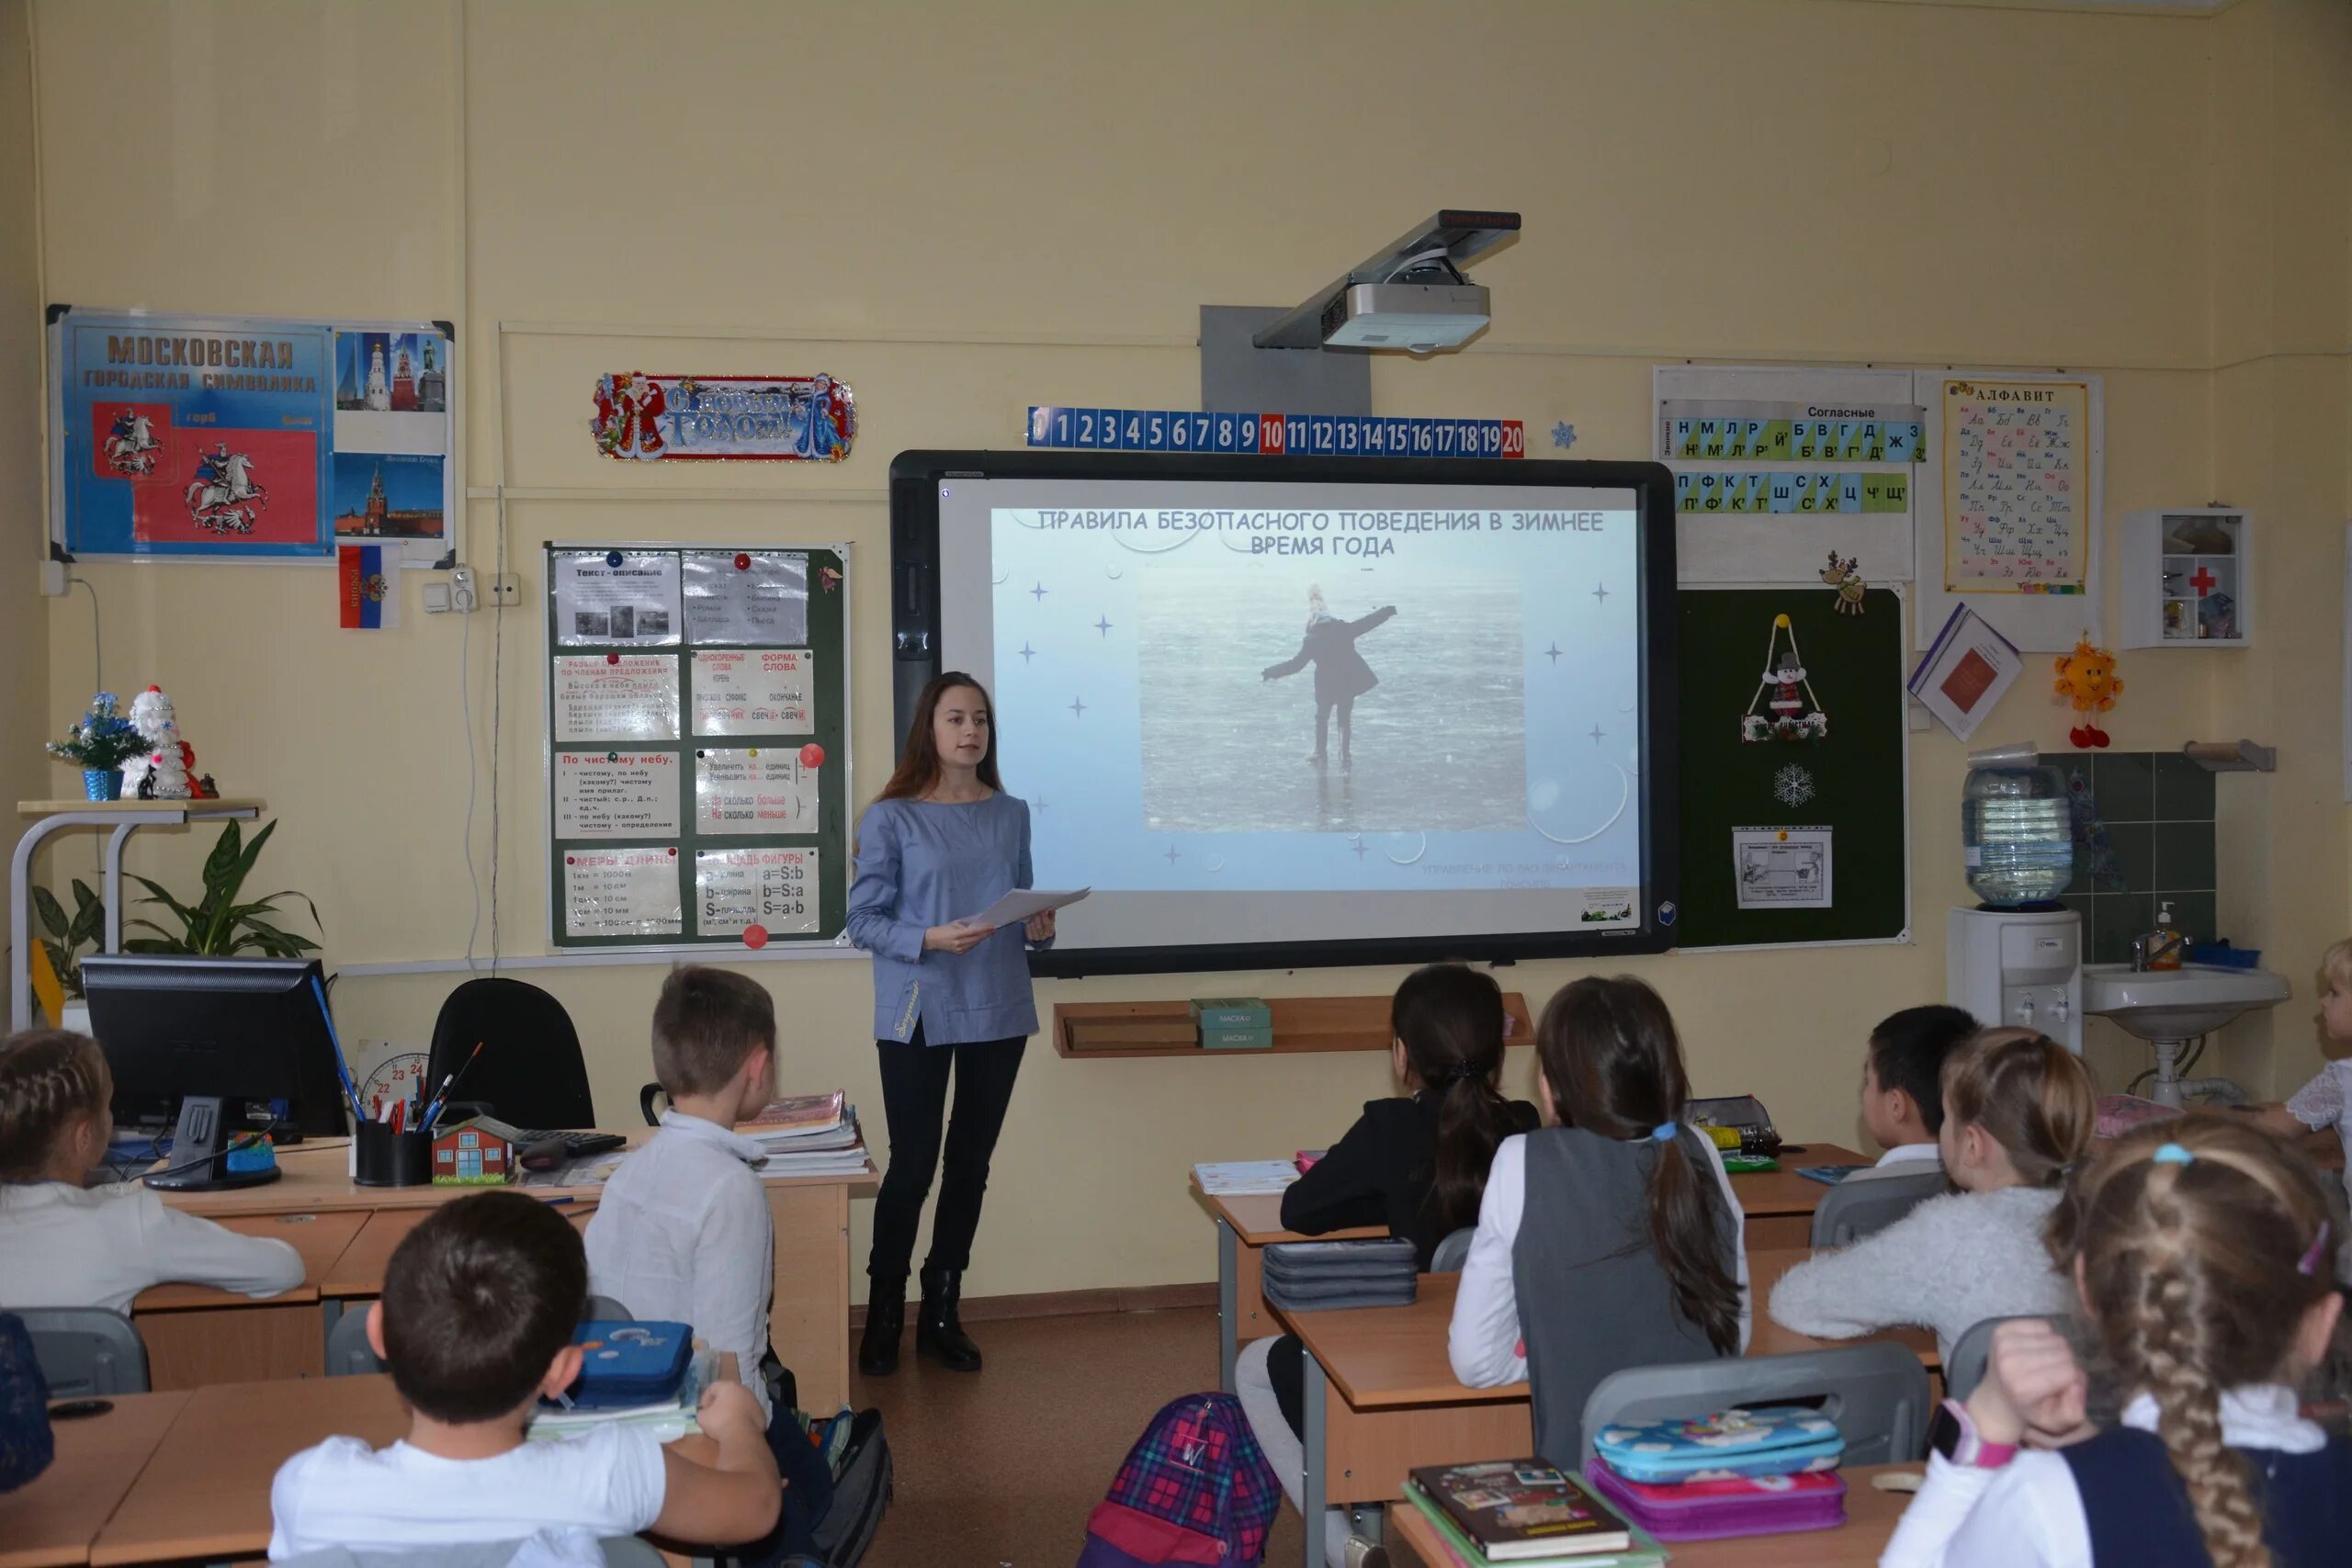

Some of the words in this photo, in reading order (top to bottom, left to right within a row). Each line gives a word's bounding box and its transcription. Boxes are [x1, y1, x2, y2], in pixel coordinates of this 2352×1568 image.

[107, 335, 293, 369] МОСКОВСКАЯ
[84, 370, 190, 390] ГОРОДСКАЯ
[202, 373, 316, 392] СИМВОЛИКА
[664, 387, 690, 412] С
[1976, 390, 2054, 401] АЛФАВИТ
[1808, 407, 1874, 417] Согласные
[1034, 413, 1046, 440] 0
[1058, 415, 1067, 441] 1
[1080, 415, 1092, 442] 2
[1103, 416, 1115, 443] 3
[1126, 417, 1140, 444] 4
[1150, 418, 1162, 445] 5
[1173, 419, 1186, 445] 6
[1196, 420, 1209, 446] 7
[1219, 420, 1232, 446] 8
[1242, 421, 1255, 446] 9
[1262, 422, 1283, 447] 10
[1288, 422, 1306, 448] 11
[1313, 423, 1332, 448] 12
[1338, 423, 1357, 449] 13
[1362, 424, 1383, 449] 14
[1387, 424, 1407, 450] 15
[1411, 425, 1431, 451] 16
[1435, 426, 1454, 451] 17
[1458, 426, 1477, 452] 18
[1481, 426, 1500, 452] 19
[1503, 427, 1522, 452] 20
[1679, 423, 1689, 433] Н
[1702, 423, 1713, 434] М
[1726, 423, 1736, 434] Л
[1749, 423, 1758, 434] Р
[1794, 424, 1804, 435] Б
[1818, 424, 1826, 435] В
[1841, 425, 1848, 435] Г
[1864, 425, 1874, 438] Д
[1889, 436, 1903, 447] Ж
[1911, 426, 1918, 437] З
[1679, 476, 1689, 487] П
[1702, 476, 1714, 488] Ф
[1725, 476, 1735, 487] К
[1749, 476, 1758, 487] Т
[1775, 487, 1788, 498] Ш
[1796, 476, 1806, 487] С
[1819, 476, 1828, 487] Х
[1846, 487, 1856, 501] Ц
[1037, 511, 1148, 530] ПРАВИЛА
[1158, 511, 1329, 531] БЕЗОПАСНОГО
[1338, 512, 1480, 534] ПОВЕДЕНИЯ
[1490, 513, 1502, 531] В
[1512, 512, 1603, 532] ЗИМНЕЕ
[1251, 536, 1323, 555] ВРЕМЯ
[1333, 536, 1395, 558] ГОДА
[563, 755, 578, 764] По
[641, 755, 673, 764] небу.
[709, 762, 744, 772] Увеличить
[766, 763, 790, 772] единиц
[724, 796, 753, 805] сколько
[757, 795, 786, 805] больше
[712, 809, 722, 819] На
[724, 810, 753, 819] сколько
[757, 810, 786, 819] меньше
[577, 856, 617, 866] МЕРЫ
[625, 855, 676, 866] ДЛИНЫ
[763, 854, 803, 864] ФИГУРЫ
[392, 1070, 404, 1080] 23
[411, 1065, 423, 1074] 24
[378, 1083, 390, 1093] 22
